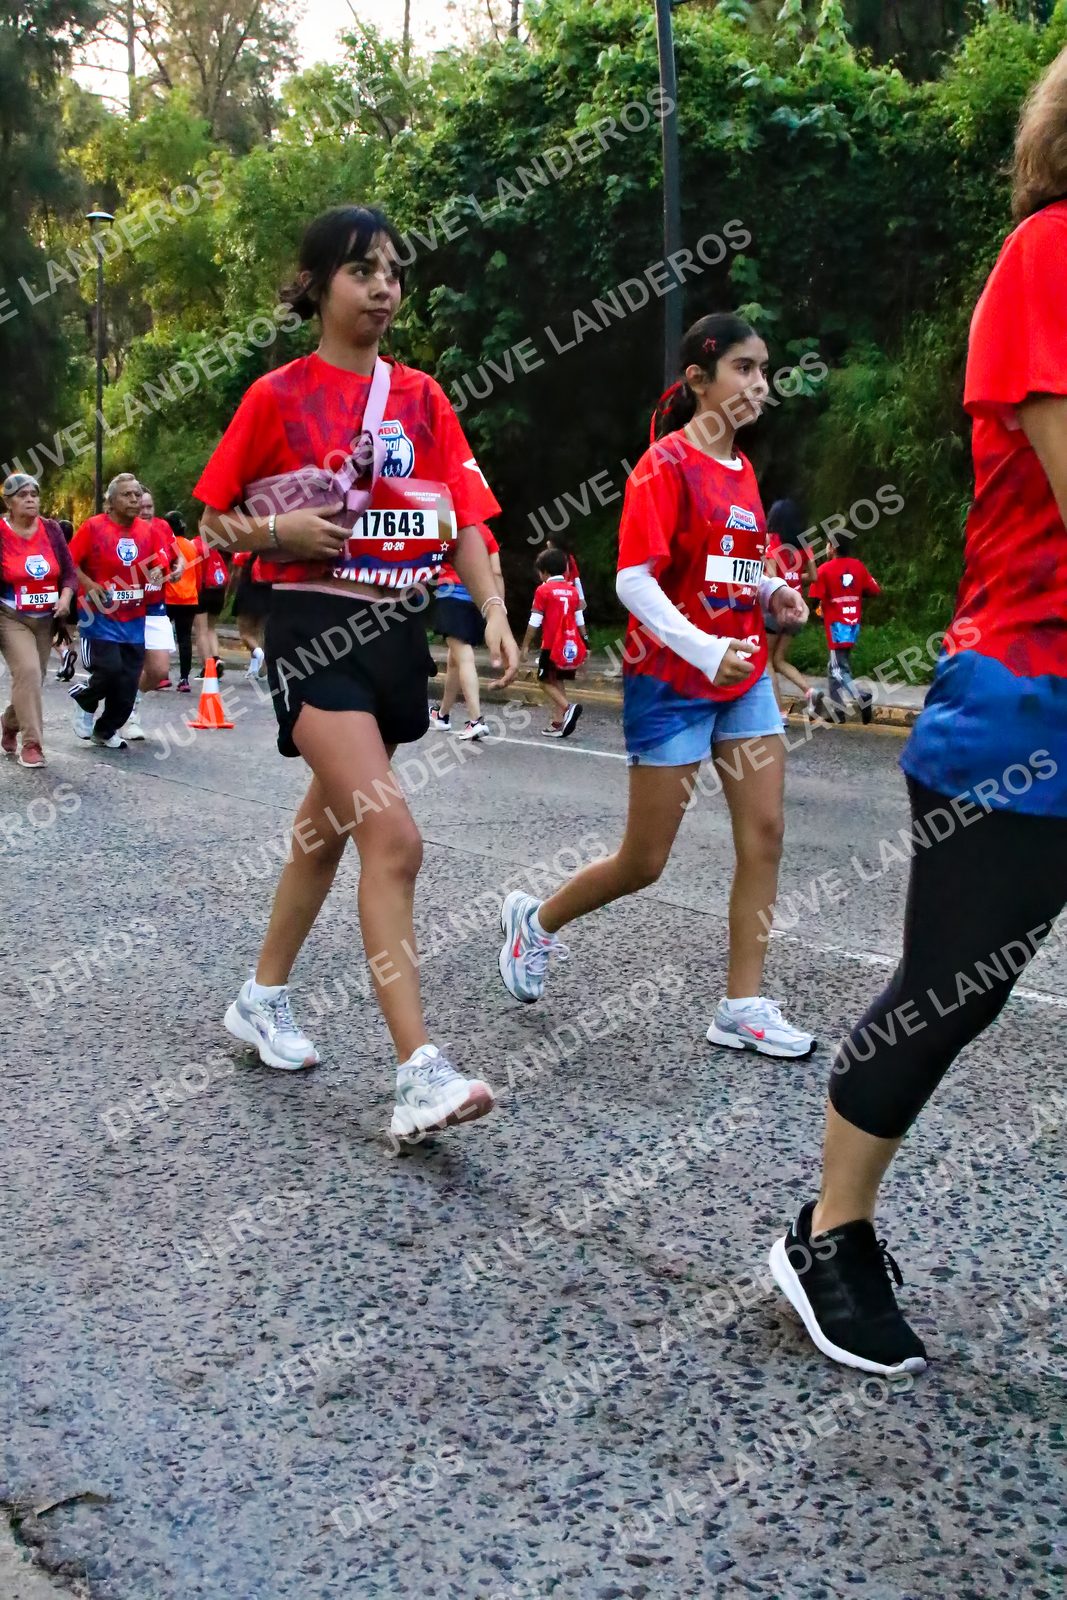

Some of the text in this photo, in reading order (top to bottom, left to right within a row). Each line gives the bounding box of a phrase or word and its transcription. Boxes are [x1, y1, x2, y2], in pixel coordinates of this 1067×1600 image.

[362, 511, 424, 537] 17643
[333, 564, 441, 589] ANTIAG
[559, 596, 569, 615] 7
